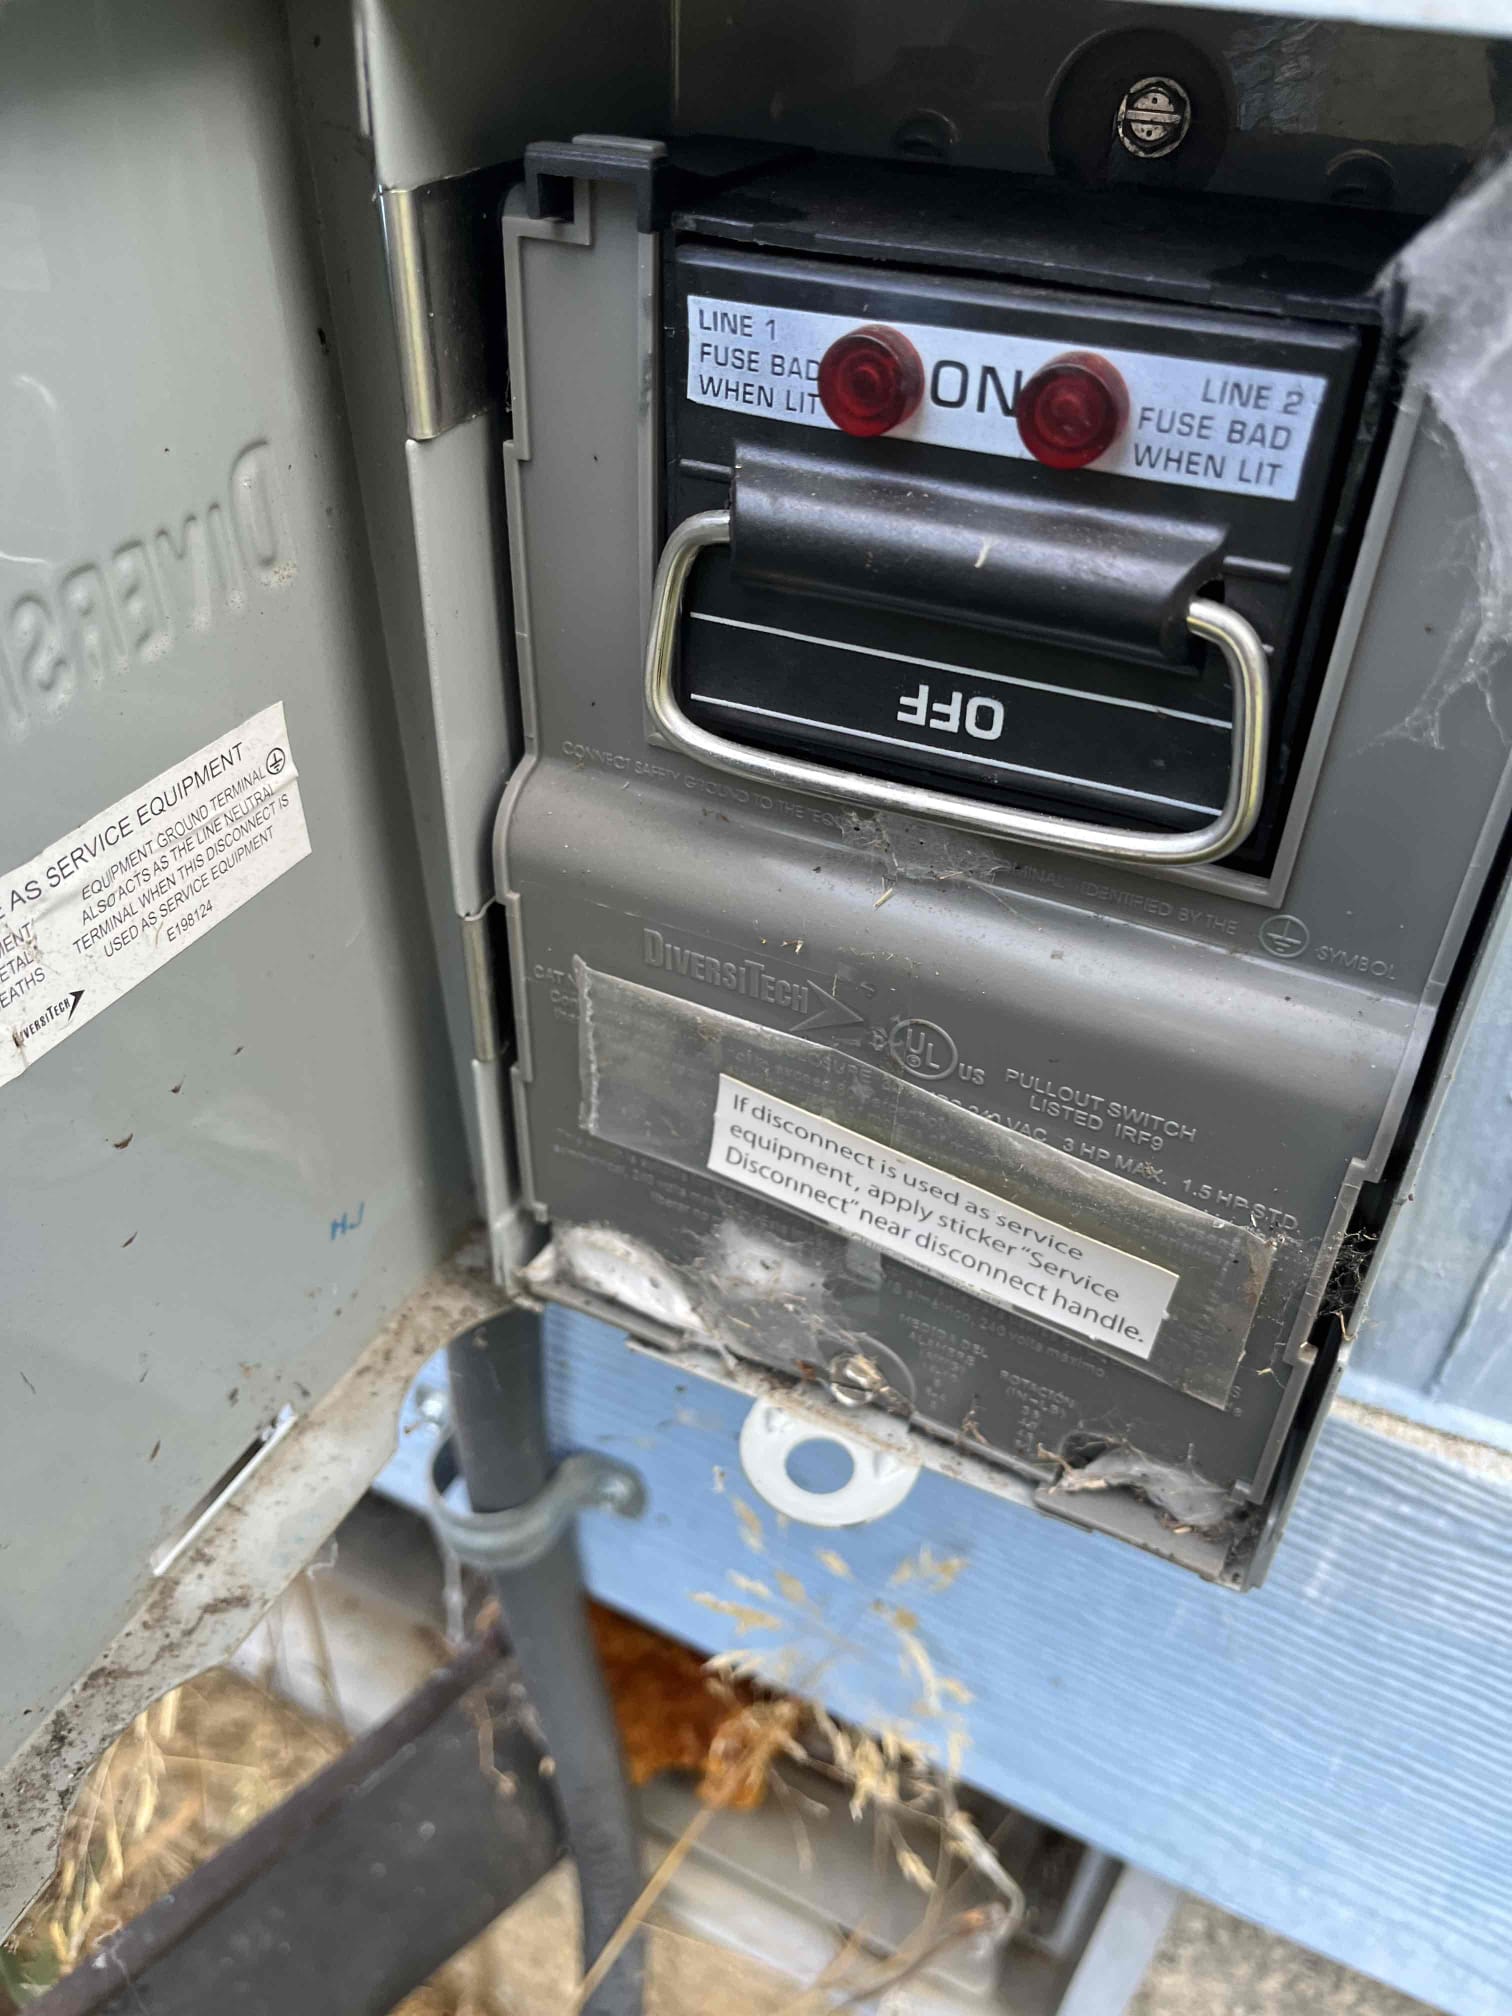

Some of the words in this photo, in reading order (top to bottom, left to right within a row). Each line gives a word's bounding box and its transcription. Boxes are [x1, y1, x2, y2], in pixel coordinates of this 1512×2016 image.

[699, 309, 752, 337] LINE
[765, 319, 776, 341] 1
[700, 343, 760, 372] FUSE
[771, 354, 820, 381] BAD
[930, 360, 1023, 417] ON
[699, 374, 774, 408] WHEN
[785, 389, 821, 414] LIT
[1200, 378, 1273, 410] LINE
[1281, 391, 1304, 415] 2
[1138, 406, 1215, 440] FUSE
[1227, 419, 1292, 451] BAD
[1134, 443, 1226, 479] WHEN
[1238, 458, 1283, 487] LIT
[897, 684, 1004, 740] OFF
[562, 740, 632, 769] CONNECT
[10, 880, 42, 912] AS
[46, 815, 134, 888] SERVICE
[136, 742, 243, 827] EQUIPMENT
[81, 840, 153, 901] EQUIPMENT
[156, 804, 209, 848] GROUND
[209, 767, 267, 812] TERMINAL
[82, 892, 116, 926] ALSO
[118, 867, 151, 901] ACTS
[153, 855, 169, 877] AS
[169, 836, 196, 862] THE
[196, 817, 223, 846] LINE
[223, 783, 275, 826] NEUTRAL
[72, 903, 139, 954] TERMINAL
[138, 873, 177, 908] WHEN
[177, 853, 205, 881] THIS
[206, 801, 277, 862] DISCONNECT
[278, 793, 290, 810] IS
[104, 924, 139, 958] USED
[141, 911, 158, 932] AS
[159, 873, 210, 918] SERVICE
[210, 825, 274, 881] EQUIPMENT
[166, 899, 214, 943] E198124
[1081, 879, 1173, 919] IDENTIFIED
[1178, 906, 1204, 925] BY
[1204, 911, 1239, 935] THE
[1317, 944, 1397, 980] SYMBOL
[906, 1028, 940, 1070] UL
[959, 1062, 985, 1085] US
[1004, 1068, 1105, 1111] PULLOUT
[1106, 1102, 1197, 1143] SWITCH
[1029, 1095, 1104, 1131] LISTED
[729, 1124, 861, 1192] equipment,
[867, 1183, 934, 1223] apply
[937, 1213, 1018, 1257] sticker
[732, 1094, 749, 1113] If
[751, 1105, 875, 1170] disconnect
[880, 1159, 897, 1179] is
[903, 1174, 960, 1207] used
[964, 1199, 990, 1220] as
[996, 1214, 1084, 1261] service
[1063, 1137, 1075, 1152] 3
[1080, 1142, 1110, 1162] HP
[1182, 1178, 1213, 1200] 1.5
[1215, 1189, 1249, 1209] HP
[859, 1207, 912, 1240] near
[914, 1232, 1051, 1302] disconnect
[1051, 1288, 1144, 1343] handle.
